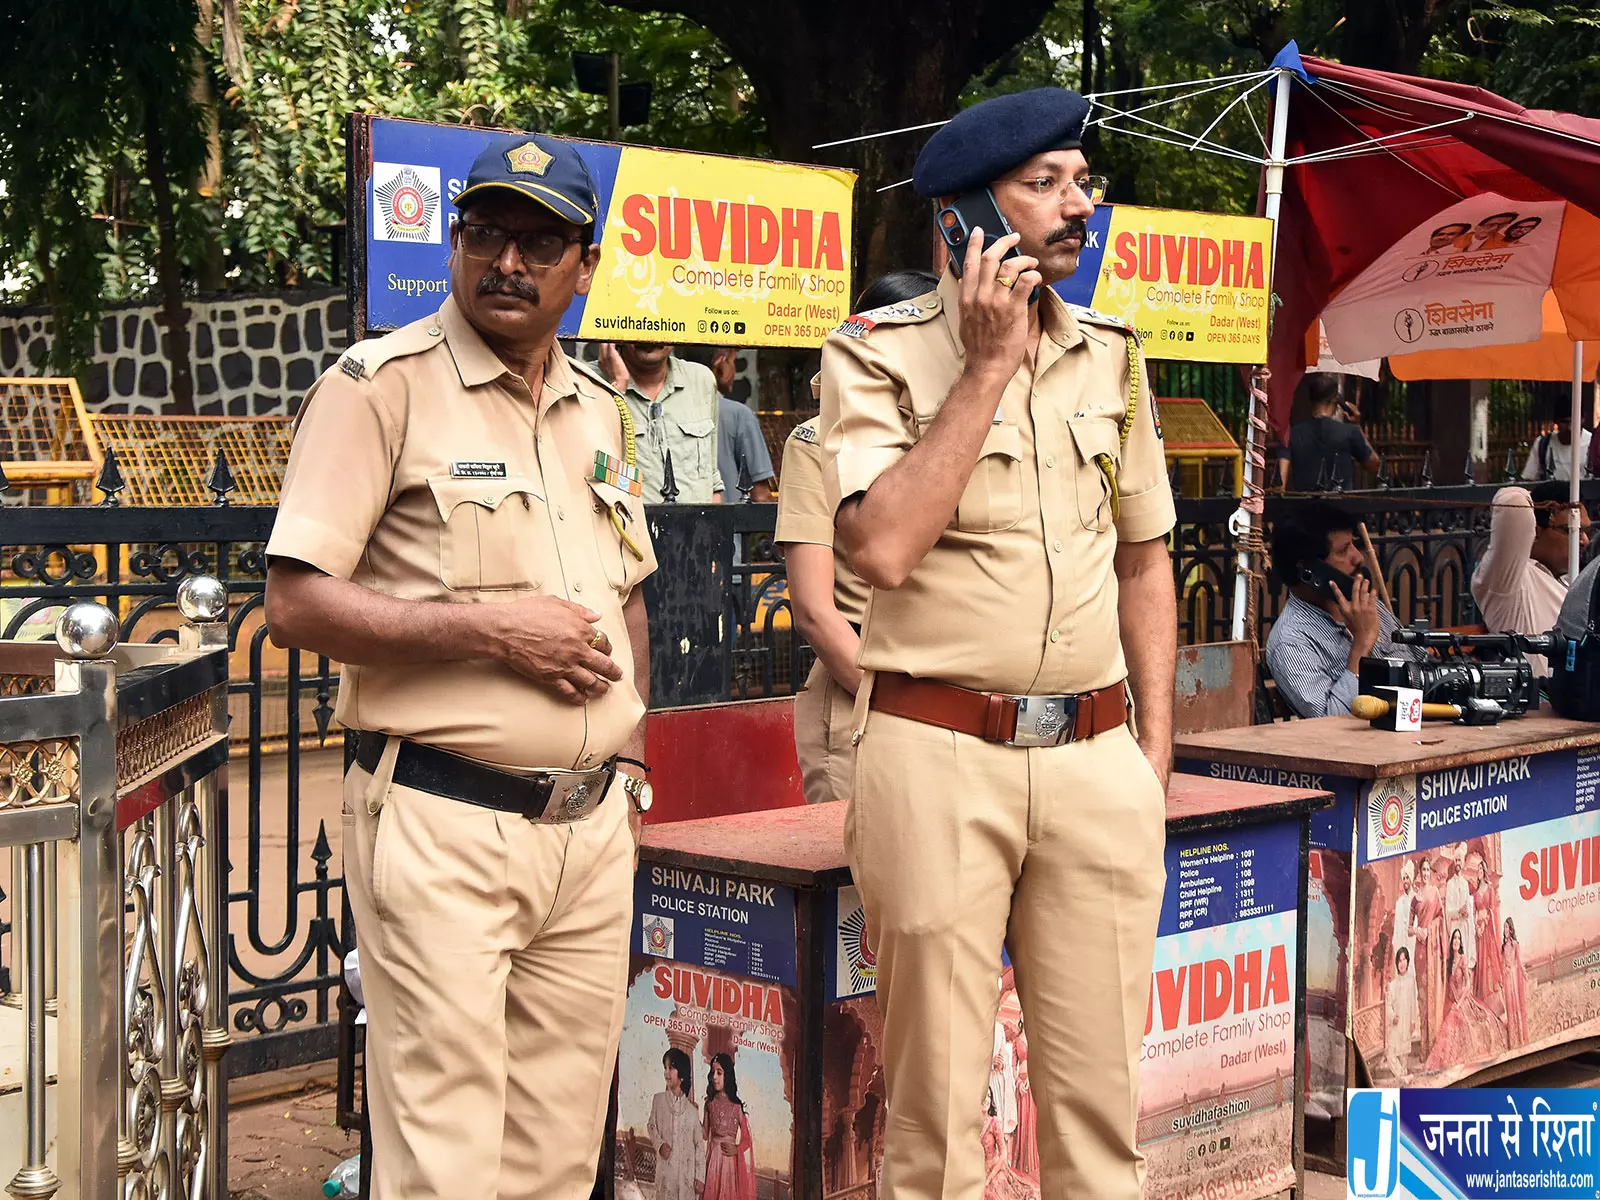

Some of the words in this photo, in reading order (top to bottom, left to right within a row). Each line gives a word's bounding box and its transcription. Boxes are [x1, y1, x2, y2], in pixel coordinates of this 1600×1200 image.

[620, 193, 844, 271] SUVIDHA
[1113, 231, 1264, 289] SUVIDHA
[1443, 252, 1514, 270] शिवसेना
[387, 273, 448, 297] Support
[672, 264, 754, 290] Complete
[758, 270, 806, 292] Family
[809, 274, 845, 297] Shop
[1146, 286, 1202, 305] Complete
[1204, 289, 1237, 308] Family
[1239, 292, 1264, 311] Shop
[704, 306, 722, 316] Follow
[767, 302, 803, 319] Dadar
[805, 303, 840, 322] (West)
[1424, 299, 1494, 326] शिवसेना
[594, 315, 686, 333] suvidhafashion
[764, 323, 793, 338] OPEN
[793, 324, 812, 338] 365
[1209, 315, 1234, 329] Dadar
[1235, 317, 1261, 332] (West)
[1475, 321, 1494, 332] ठाकरे
[1206, 332, 1227, 343] OPEN
[1227, 333, 1241, 343] 365
[1242, 335, 1261, 344] DAYS
[1210, 762, 1273, 785] SHIVAJI
[1277, 771, 1325, 790] PARK
[1420, 764, 1484, 801] SHIVAJI
[1487, 755, 1532, 788] PARK
[1576, 780, 1588, 788] Child
[1577, 771, 1600, 780] Ambulance
[1575, 804, 1586, 812] GRP
[1585, 794, 1595, 803] (CR)
[1420, 806, 1462, 830] POLICE
[1462, 794, 1508, 818] STATION
[1179, 845, 1211, 858] HELPLINE
[1212, 843, 1229, 854] NOS.
[1179, 856, 1209, 868] Women's
[1209, 852, 1235, 865] Helpline
[1241, 849, 1255, 858] 1091
[1179, 869, 1200, 879] Police
[1240, 859, 1252, 868] 100
[1179, 876, 1215, 890] Ambulance
[1240, 870, 1252, 878] 108
[651, 866, 720, 897] SHIVAJI
[725, 879, 775, 907] PARK
[1179, 888, 1197, 900] Child
[1197, 885, 1223, 898] Helpline
[1240, 878, 1255, 888] 1098
[651, 893, 695, 915] POLICE
[697, 902, 749, 925] STATION
[1179, 899, 1193, 910] RPF
[1193, 897, 1209, 908] (WR)
[1240, 888, 1254, 898] 1311
[1179, 910, 1193, 920] RPF
[1193, 908, 1208, 918] (CR)
[1240, 898, 1255, 908] 1275
[1547, 890, 1596, 914] Complete
[1179, 920, 1194, 930] GRP
[653, 965, 784, 1026] SUVIDHA
[643, 1014, 666, 1028] OPEN
[667, 1018, 683, 1032] 365
[684, 1022, 708, 1038] DAYS
[679, 1005, 726, 1027] Complete
[728, 1015, 757, 1035] Family
[759, 1022, 785, 1040] Shop
[1212, 1017, 1256, 1045] Family
[1258, 1010, 1291, 1033] Shop
[733, 1034, 756, 1050] Dadar
[756, 1037, 781, 1056] (West)
[1220, 1051, 1251, 1069] Dadar
[1254, 1038, 1288, 1065] (West)
[1172, 1098, 1250, 1131] suvidhafashion
[1193, 1129, 1210, 1140] Follow
[1196, 1178, 1227, 1200] 365
[1231, 1161, 1278, 1195] DAYS
